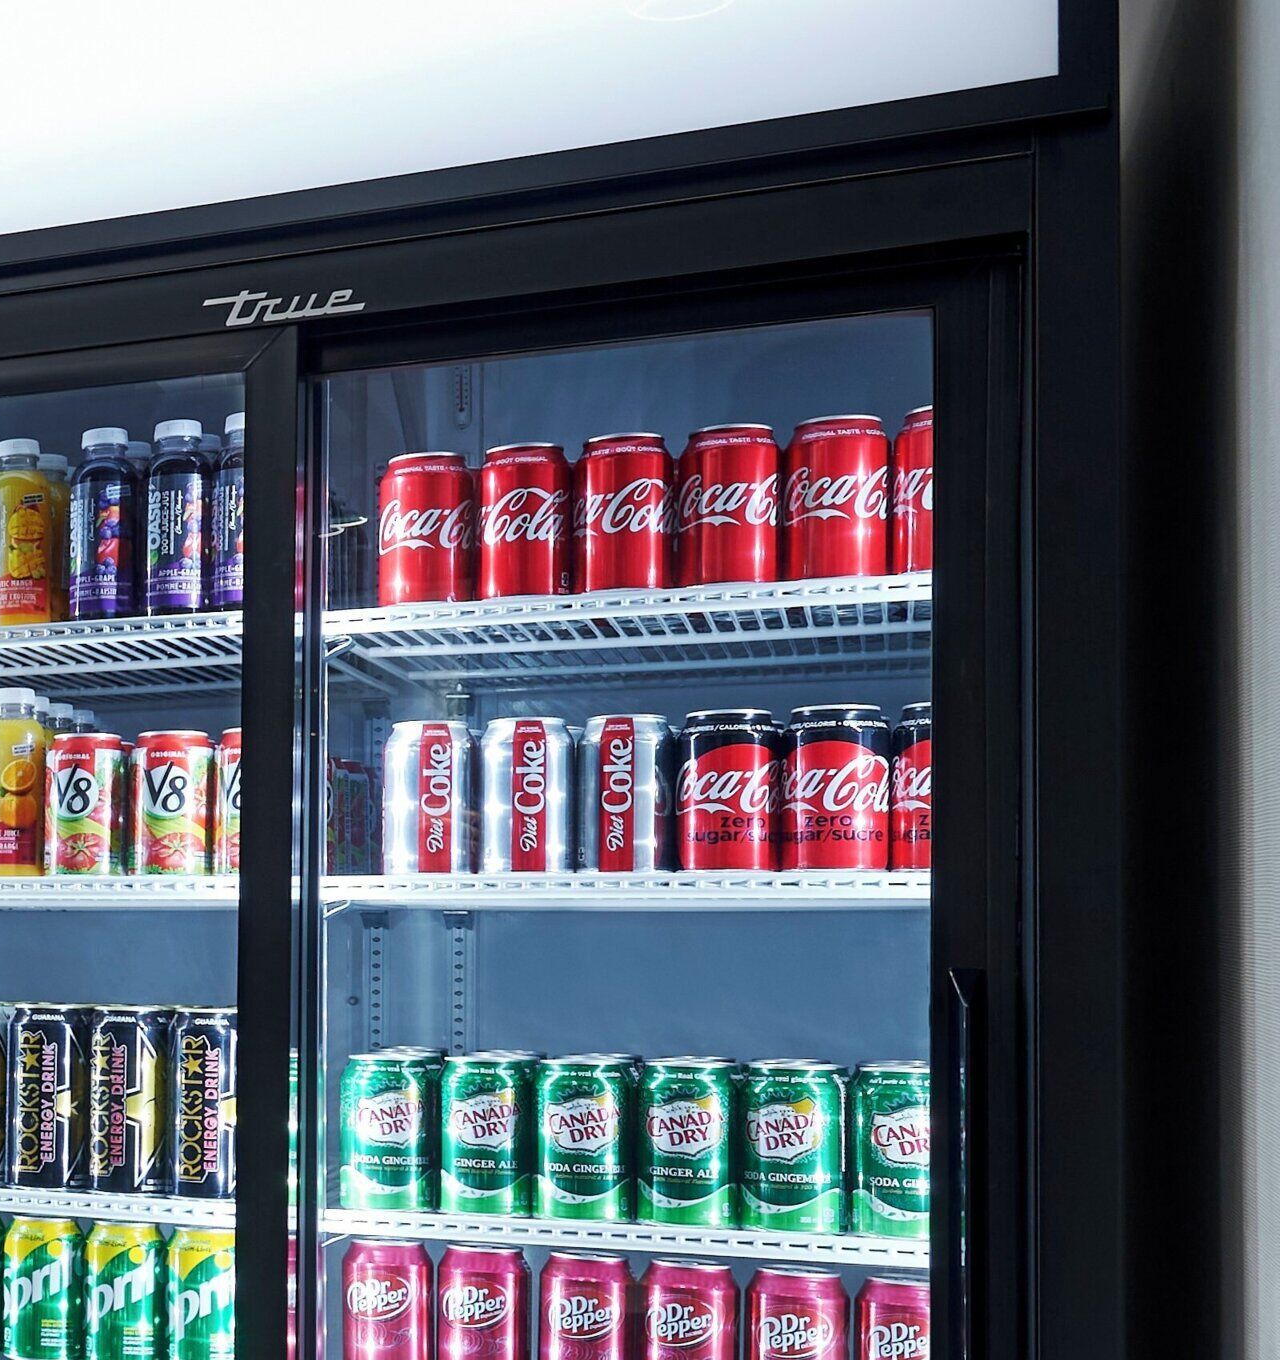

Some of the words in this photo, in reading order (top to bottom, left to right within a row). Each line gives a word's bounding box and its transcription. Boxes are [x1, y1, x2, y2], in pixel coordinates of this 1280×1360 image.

[202, 289, 366, 327] true
[143, 761, 188, 812] V8
[421, 743, 452, 816] Coke
[514, 739, 546, 814] Coke
[601, 736, 633, 813] Coke
[427, 818, 444, 852] Diet
[520, 817, 538, 852] Diet
[607, 815, 624, 851] Diet
[721, 815, 766, 828] zero
[805, 815, 852, 827] zero
[41, 1044, 56, 1093] DRINK
[111, 1047, 125, 1096] DRINK
[204, 1049, 221, 1100] DRINK
[40, 1099, 55, 1162] ENERGY
[379, 1118, 414, 1136] DRY
[454, 1102, 521, 1129] CANADA
[472, 1120, 509, 1138] DRY
[549, 1106, 620, 1134] CANADA
[647, 1111, 723, 1137] CANADA
[109, 1102, 125, 1165] ENERGY
[203, 1106, 218, 1171] ENERGY
[569, 1123, 608, 1143] DRY
[669, 1128, 710, 1147] DRY
[765, 1131, 806, 1151] DRY
[455, 1158, 496, 1169] GINGER
[499, 1159, 518, 1169] ALE
[650, 1166, 694, 1178] GINGER
[870, 1177, 899, 1188] SODA
[443, 1287, 504, 1321] Pepper
[462, 1287, 489, 1304] Dr
[667, 1303, 694, 1321] Dr
[648, 1305, 710, 1340] Pepper
[761, 1317, 827, 1353] Pepper
[781, 1314, 811, 1331] Dr
